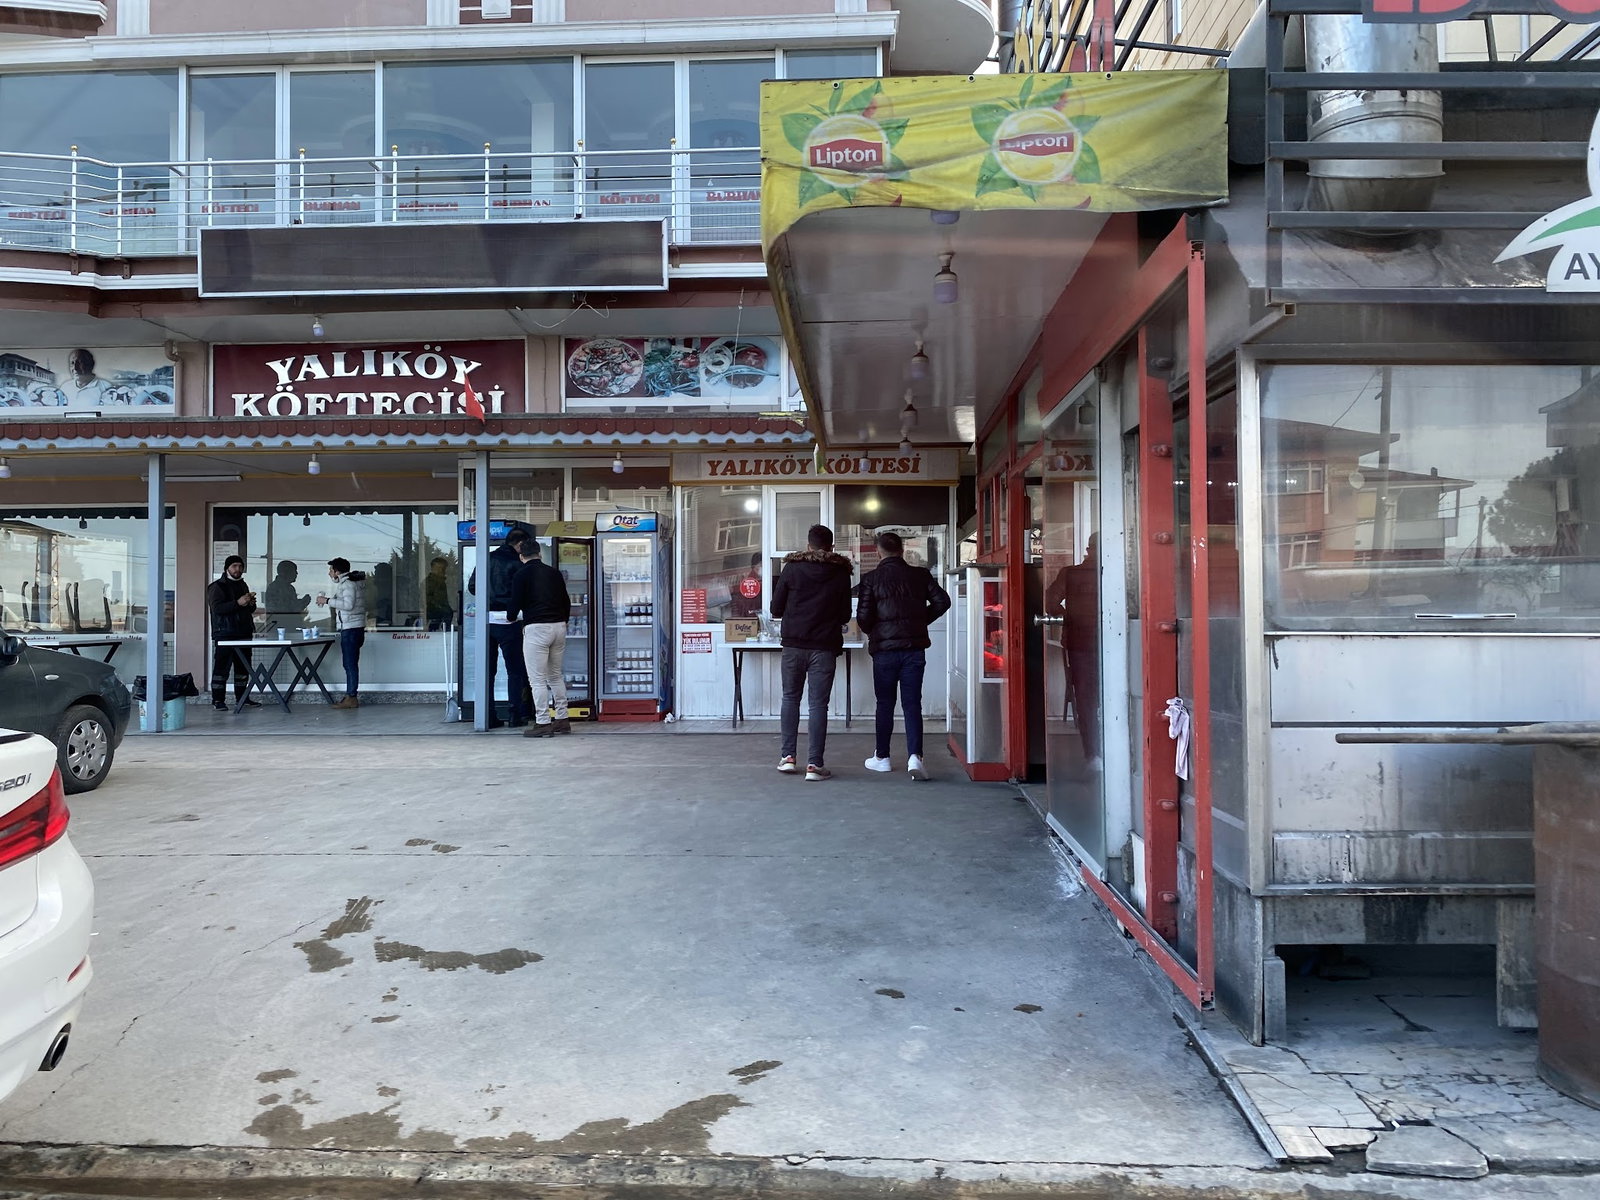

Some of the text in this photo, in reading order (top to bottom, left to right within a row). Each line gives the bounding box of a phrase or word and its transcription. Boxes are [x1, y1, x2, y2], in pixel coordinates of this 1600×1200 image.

[816, 147, 877, 167] Lipton
[265, 343, 482, 386] YALIKÖY
[707, 454, 813, 476] YALIKÖY
